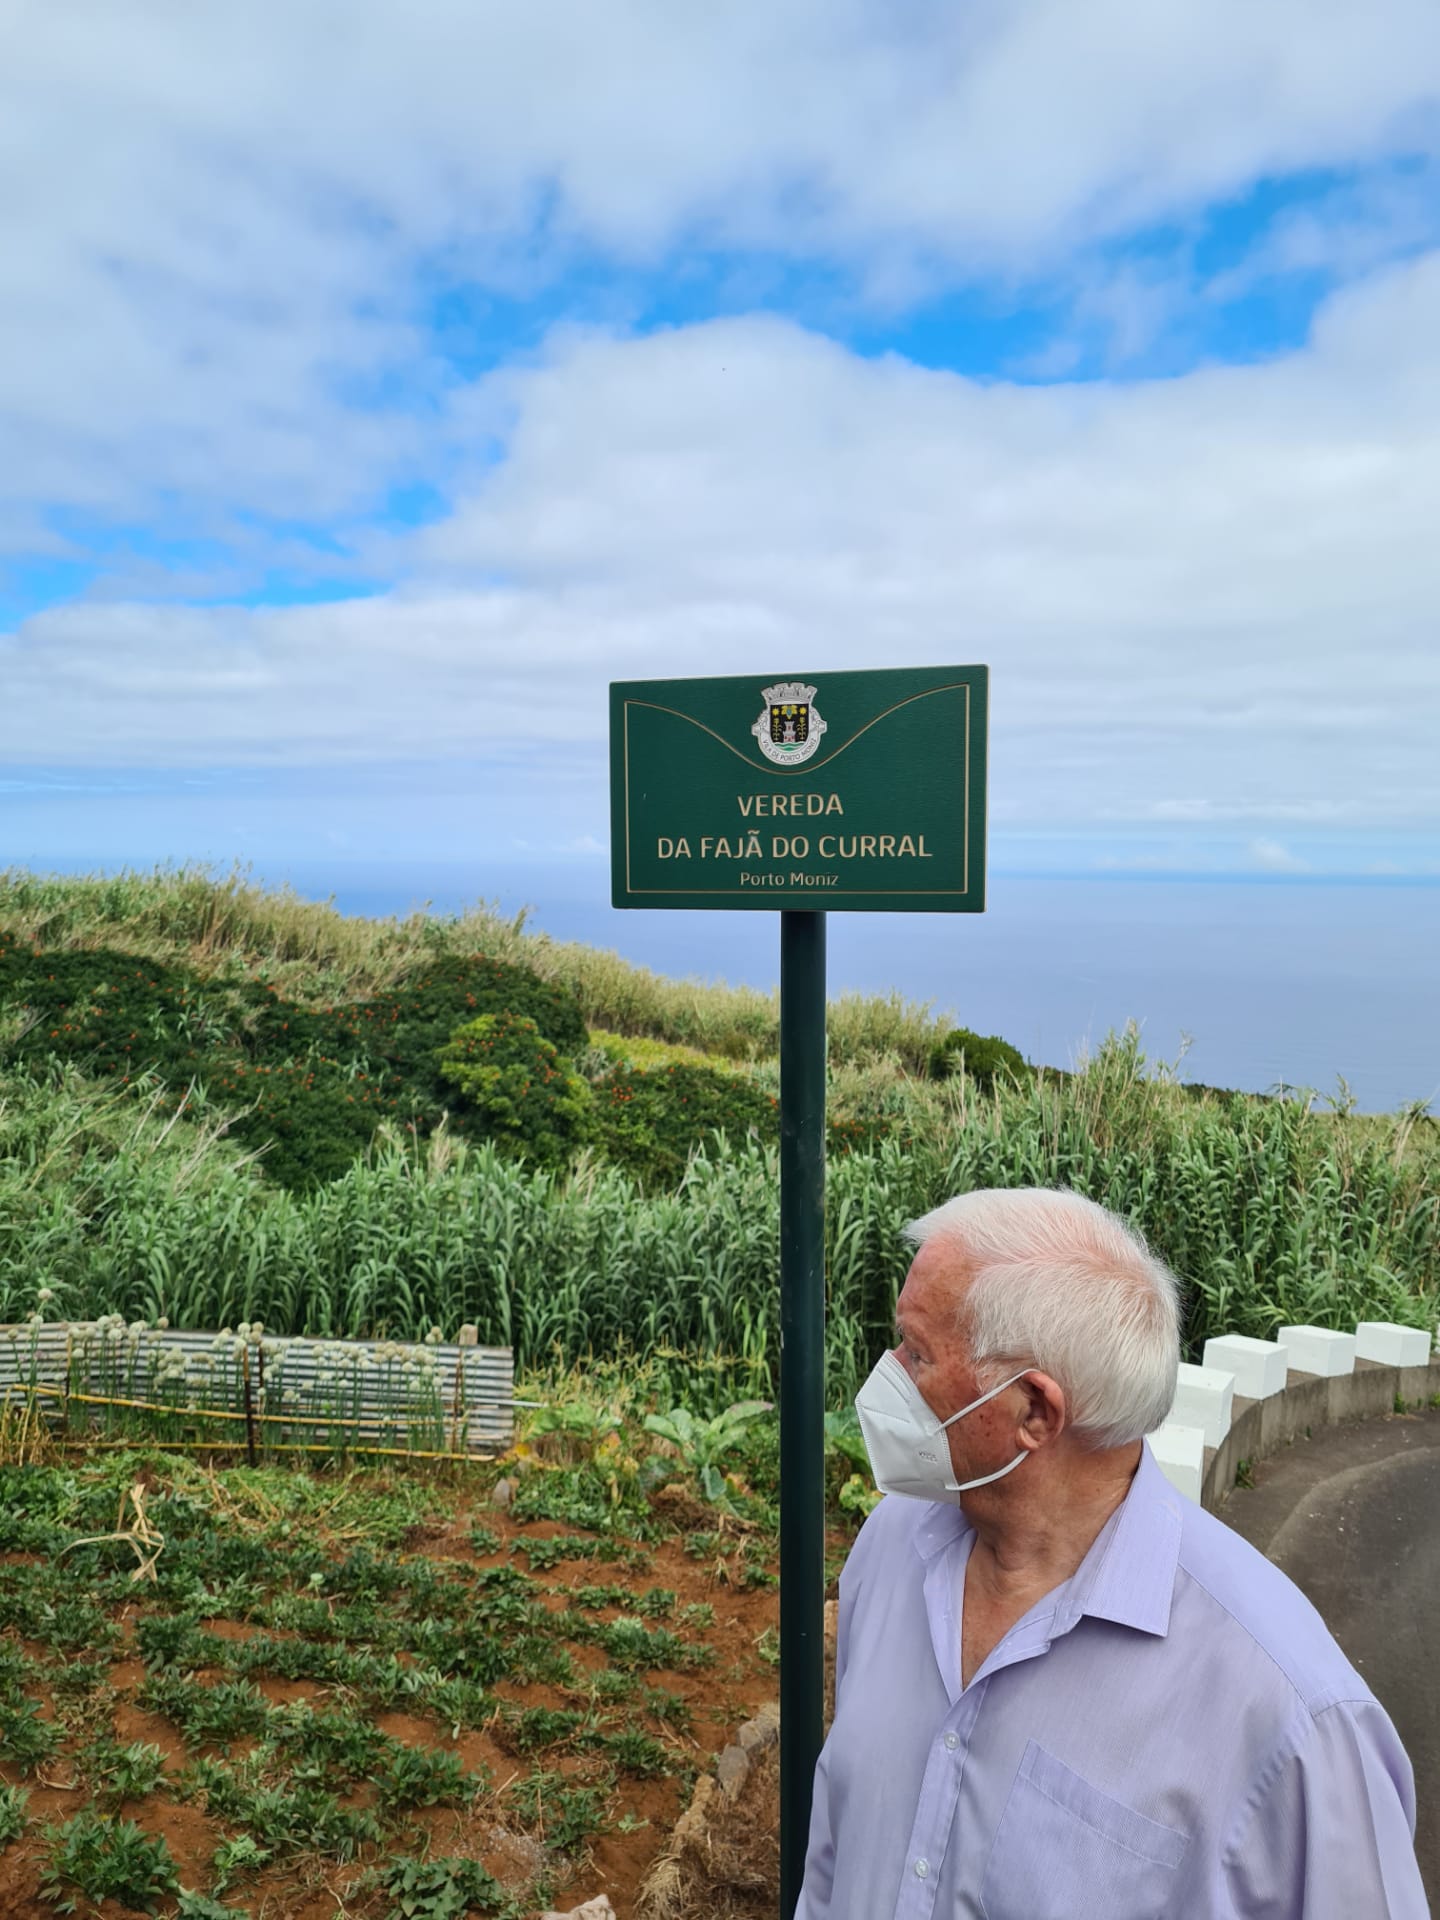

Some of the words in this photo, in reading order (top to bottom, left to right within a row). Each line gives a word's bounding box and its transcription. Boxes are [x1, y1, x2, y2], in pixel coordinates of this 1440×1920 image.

[780, 753, 801, 761] PORTO
[737, 793, 844, 817] VEREDA
[657, 837, 692, 859] DA
[700, 829, 763, 859] FAJÃ
[772, 836, 810, 858] DO
[818, 834, 934, 858] CURRAL
[740, 872, 785, 886] Porto
[789, 872, 839, 886] Moniz
